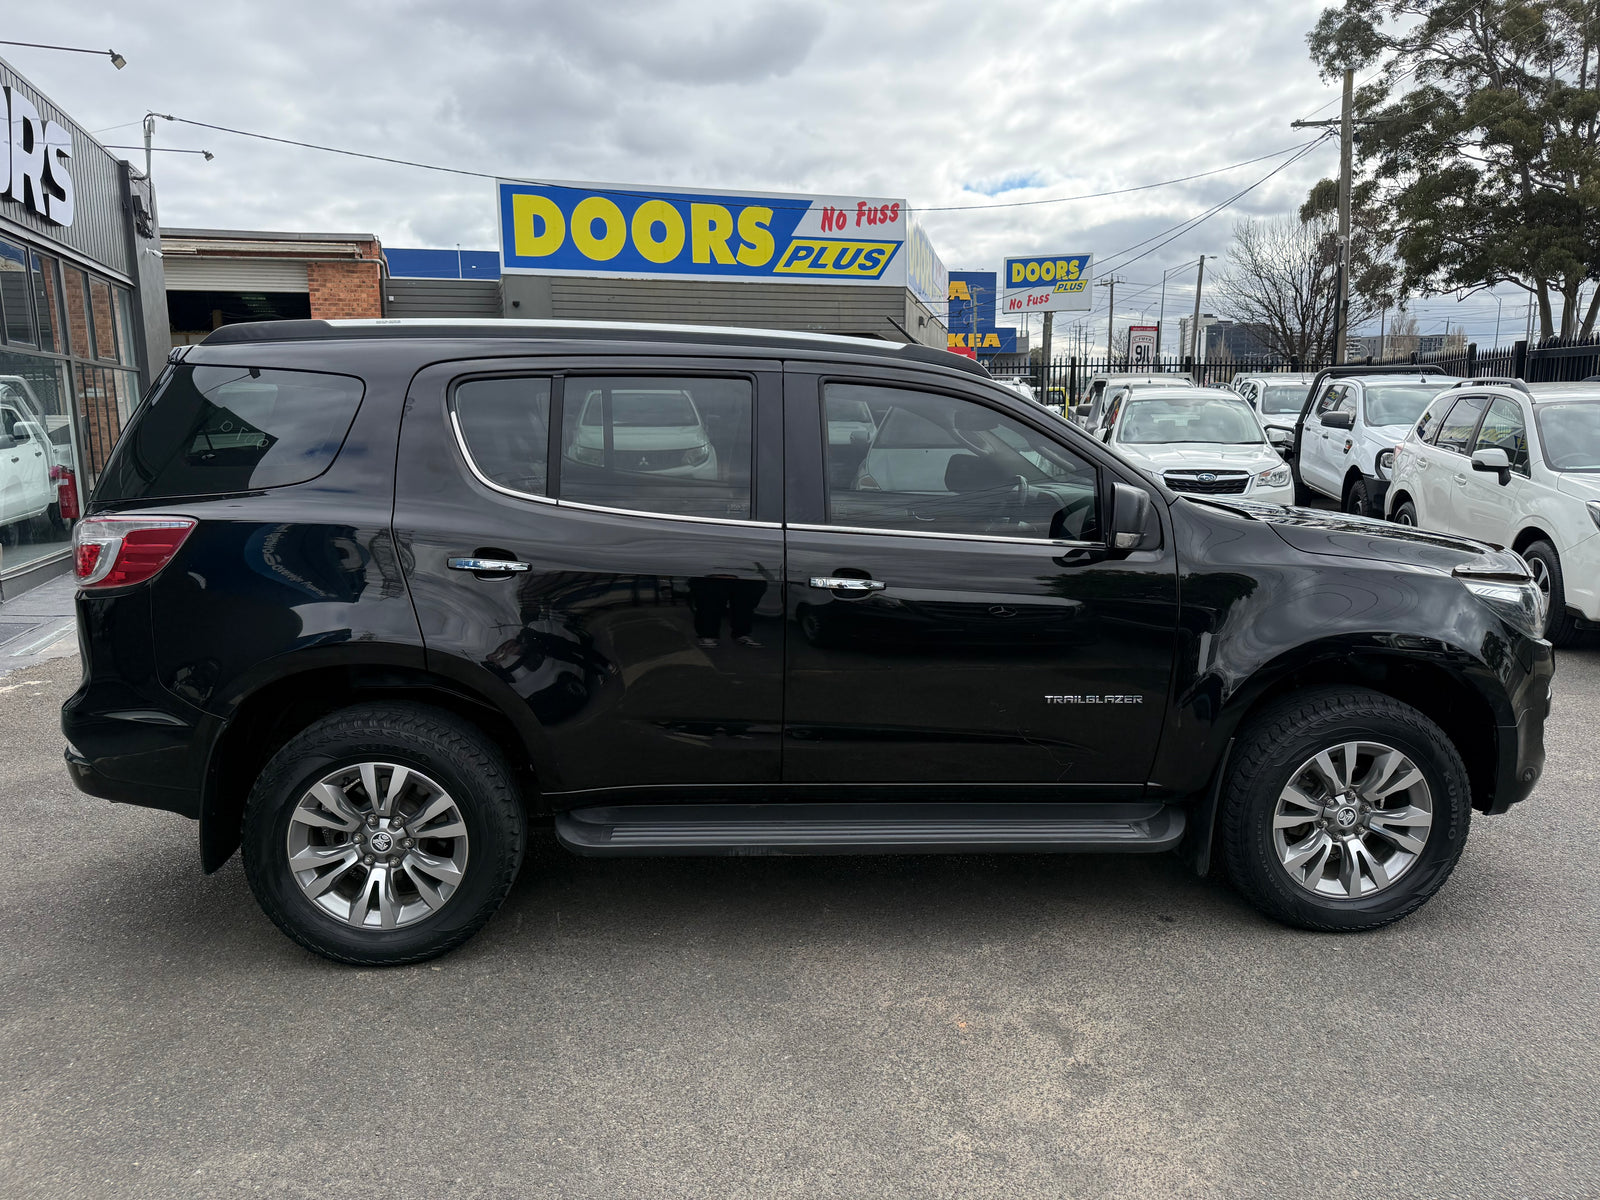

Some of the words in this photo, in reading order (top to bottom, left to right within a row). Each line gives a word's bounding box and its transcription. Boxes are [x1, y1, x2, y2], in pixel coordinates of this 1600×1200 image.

[820, 205, 848, 233] No
[855, 200, 900, 228] Fuss
[512, 193, 776, 267] DOORS
[783, 244, 887, 271] PLUS
[1012, 259, 1080, 283] DOORS
[1056, 282, 1083, 292] PLUS
[1009, 298, 1023, 311] No
[1026, 293, 1050, 307] Fuss
[1044, 695, 1143, 704] TRAILBLAZER
